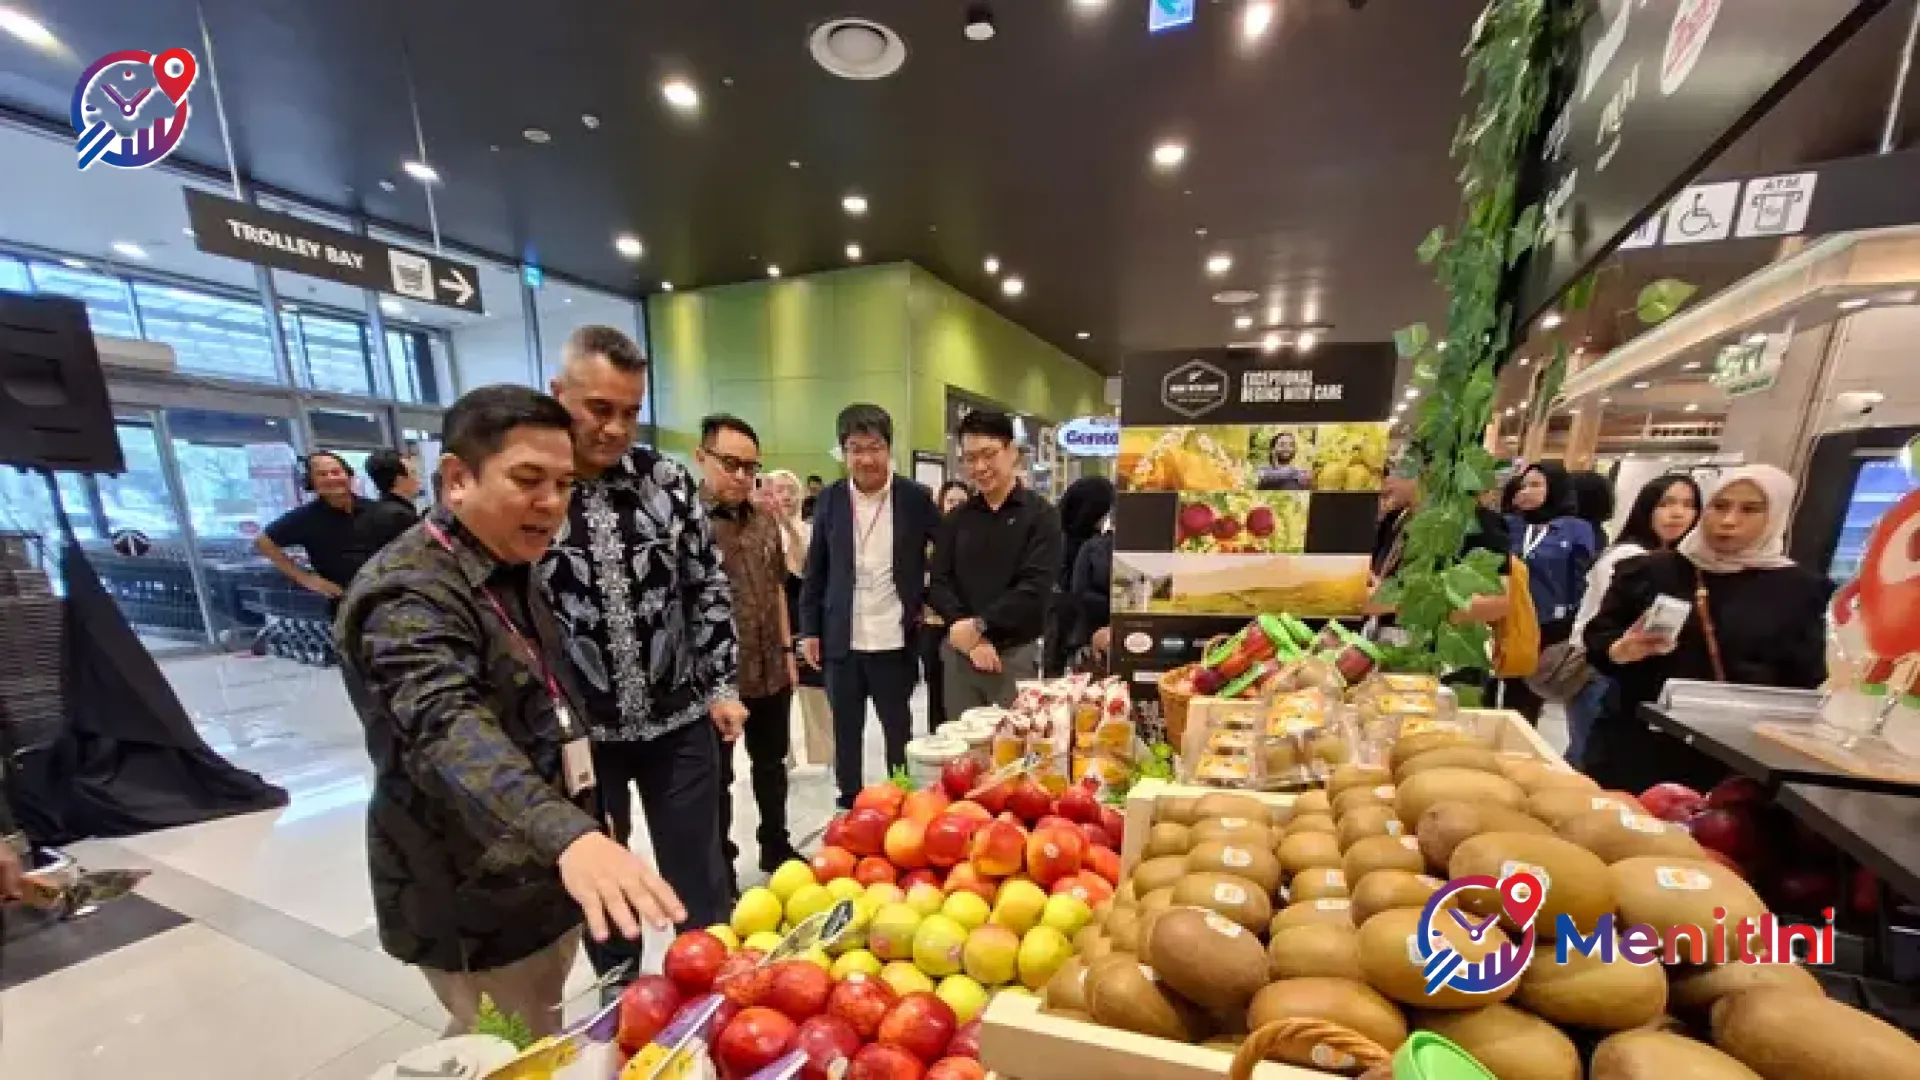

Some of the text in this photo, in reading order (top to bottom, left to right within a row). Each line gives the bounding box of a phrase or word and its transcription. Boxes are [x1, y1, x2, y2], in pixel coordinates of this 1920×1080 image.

[1763, 176, 1801, 191] ATM
[226, 218, 364, 269] TROLLEY BAY
[1314, 384, 1344, 400] CARE
